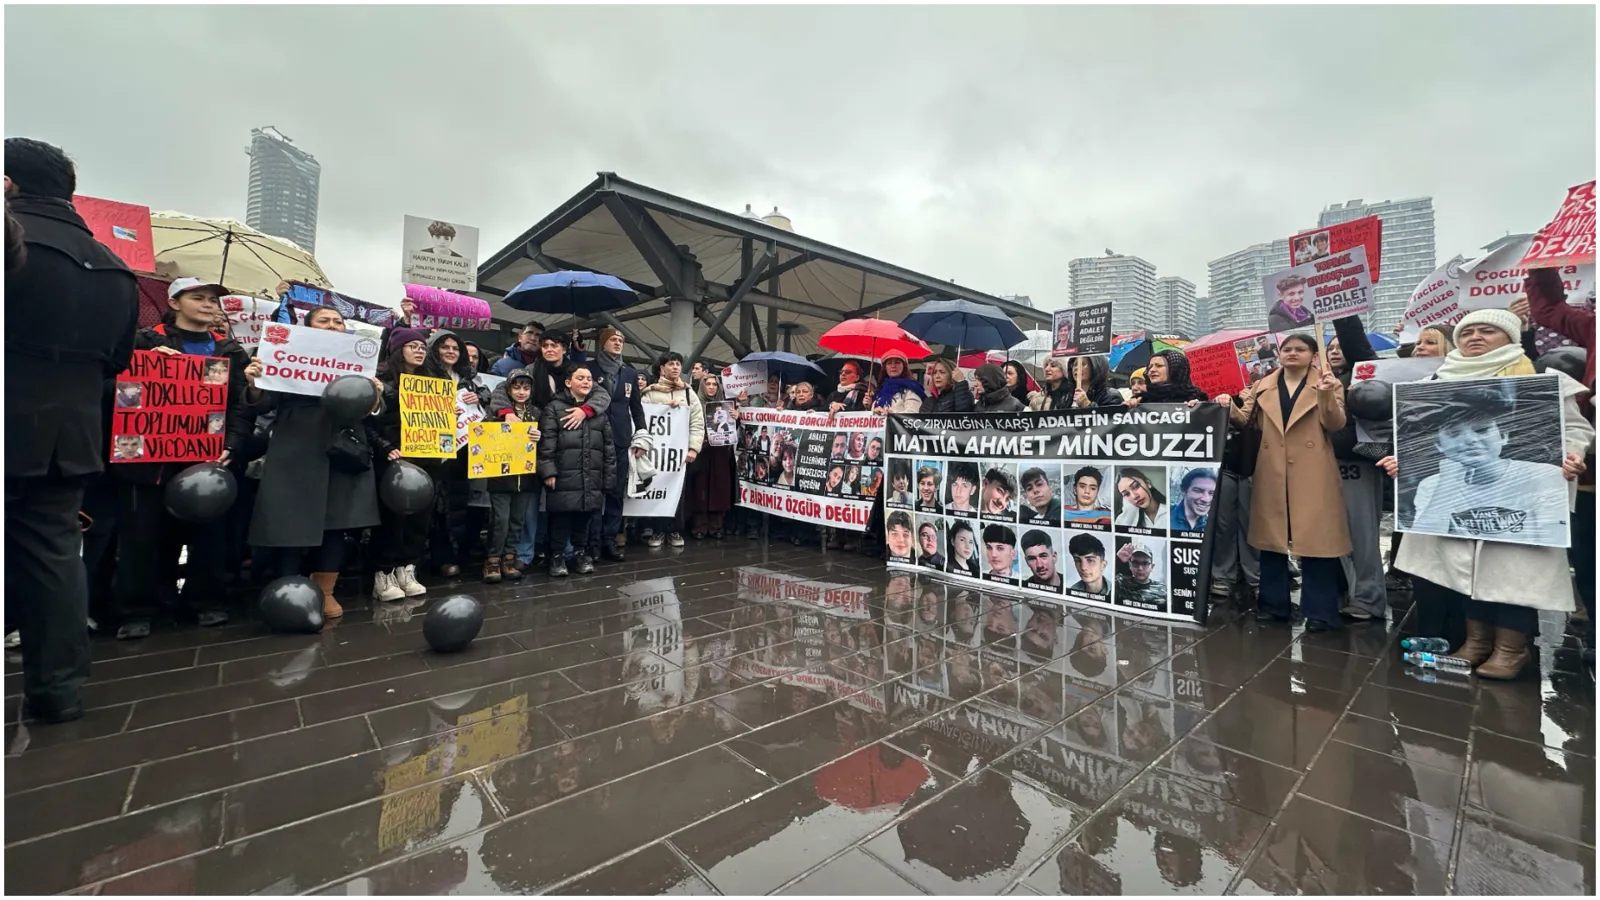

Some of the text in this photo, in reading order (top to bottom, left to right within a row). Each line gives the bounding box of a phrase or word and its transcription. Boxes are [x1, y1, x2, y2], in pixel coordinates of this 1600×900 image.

[1315, 253, 1352, 273] TOPRAK
[1312, 286, 1368, 310] ADALET
[1315, 282, 1340, 297] Erken
[1470, 280, 1582, 298] DOKUA!
[1314, 306, 1334, 315] HALA
[1415, 302, 1458, 327] İstisma
[1079, 325, 1106, 335] ADALET
[1080, 316, 1106, 326] ADALET
[273, 350, 364, 374] Çocuklara
[265, 365, 339, 385] DOKUN
[141, 381, 224, 407] YOKLUĞU
[402, 377, 455, 397] ÇOCUKLAR
[117, 411, 209, 435] TOPLUMUN
[456, 413, 481, 430] Ortak
[648, 412, 672, 436] ESİ
[902, 407, 1191, 432] SSÇ ZIRVALIĞINA KARŞI ADALETİN SANCAĞI
[144, 437, 223, 459] VİCDANI!
[893, 426, 1214, 458] MATTİA AHMET MİNGUZZİ
[1339, 464, 1361, 480] 23
[749, 487, 783, 511] BİRİMİZ
[785, 495, 822, 519] ÖZGÜR
[825, 503, 869, 526] DEĞİLİ
[1470, 509, 1499, 518] VANS
[1475, 519, 1498, 531] THE
[1173, 547, 1200, 565] SUS
